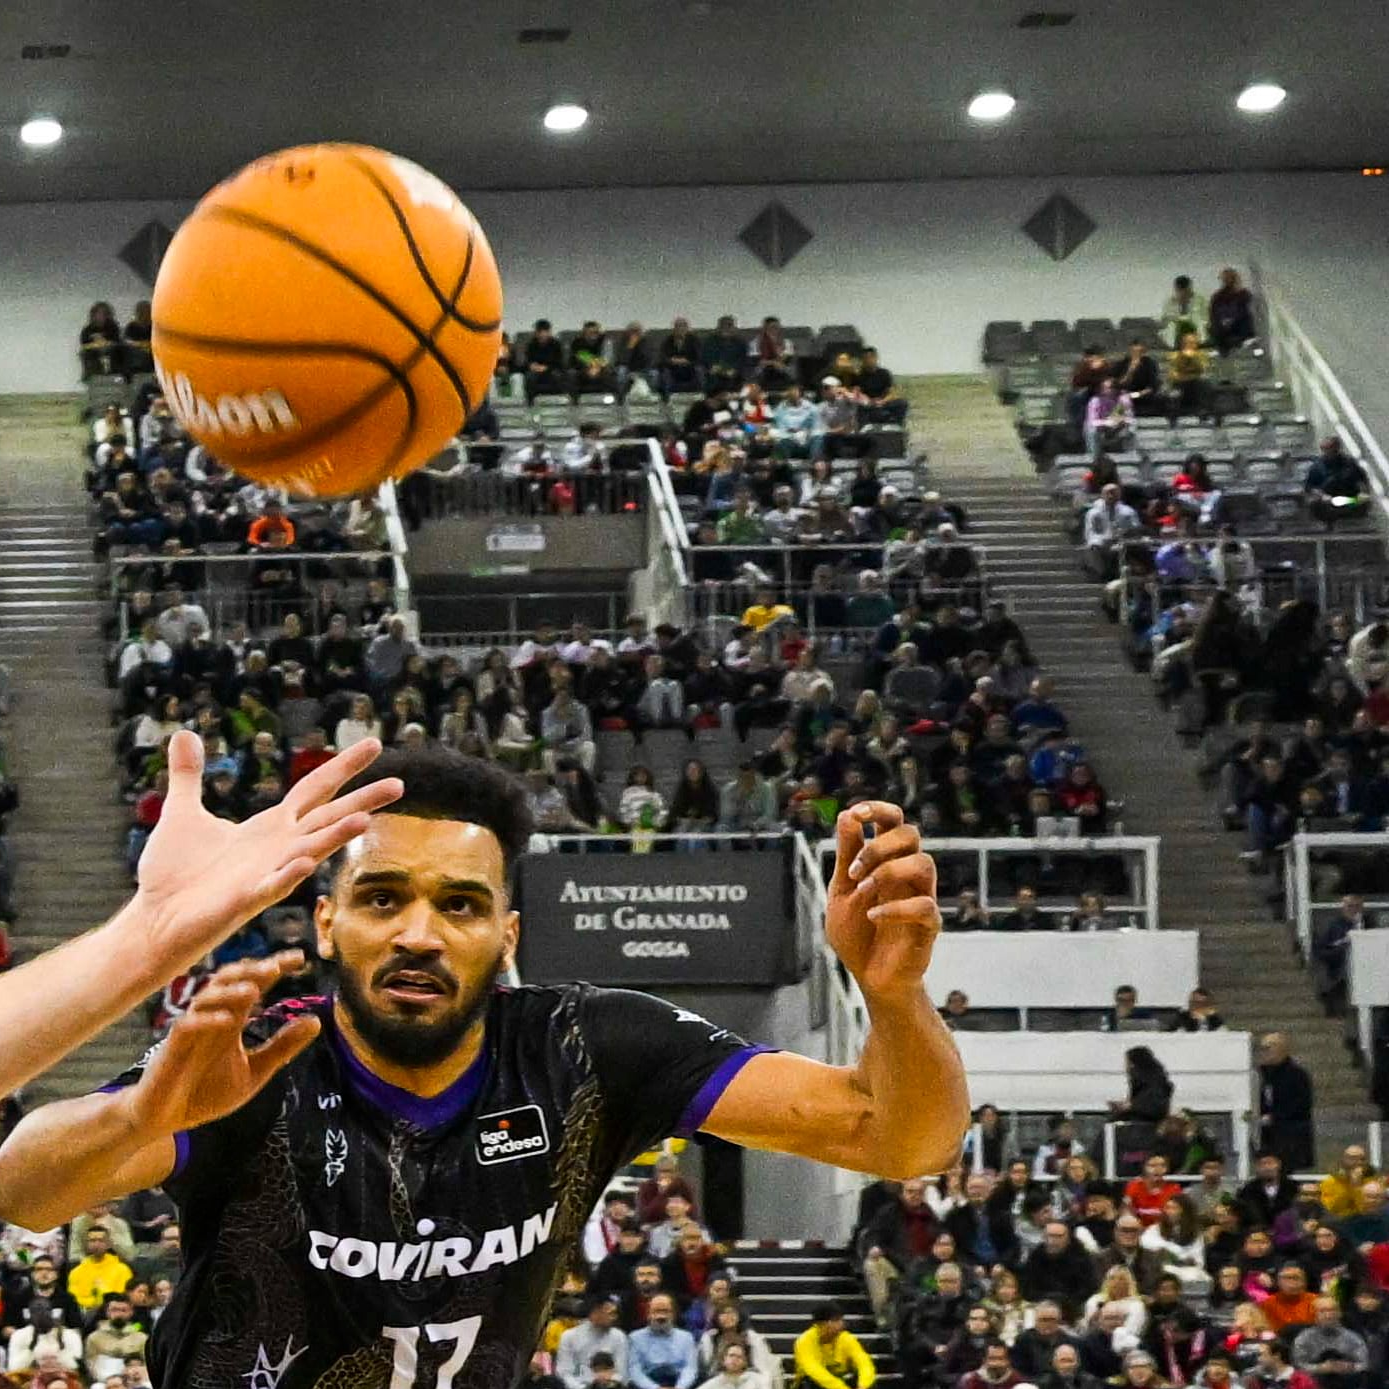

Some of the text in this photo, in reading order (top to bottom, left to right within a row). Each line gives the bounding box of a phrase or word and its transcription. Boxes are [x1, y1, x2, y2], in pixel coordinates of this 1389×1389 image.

[559, 880, 748, 903] AYUNTAMIENTO
[613, 906, 731, 931] GRANADA
[480, 1129, 509, 1144] liga
[483, 1135, 543, 1156] endesa
